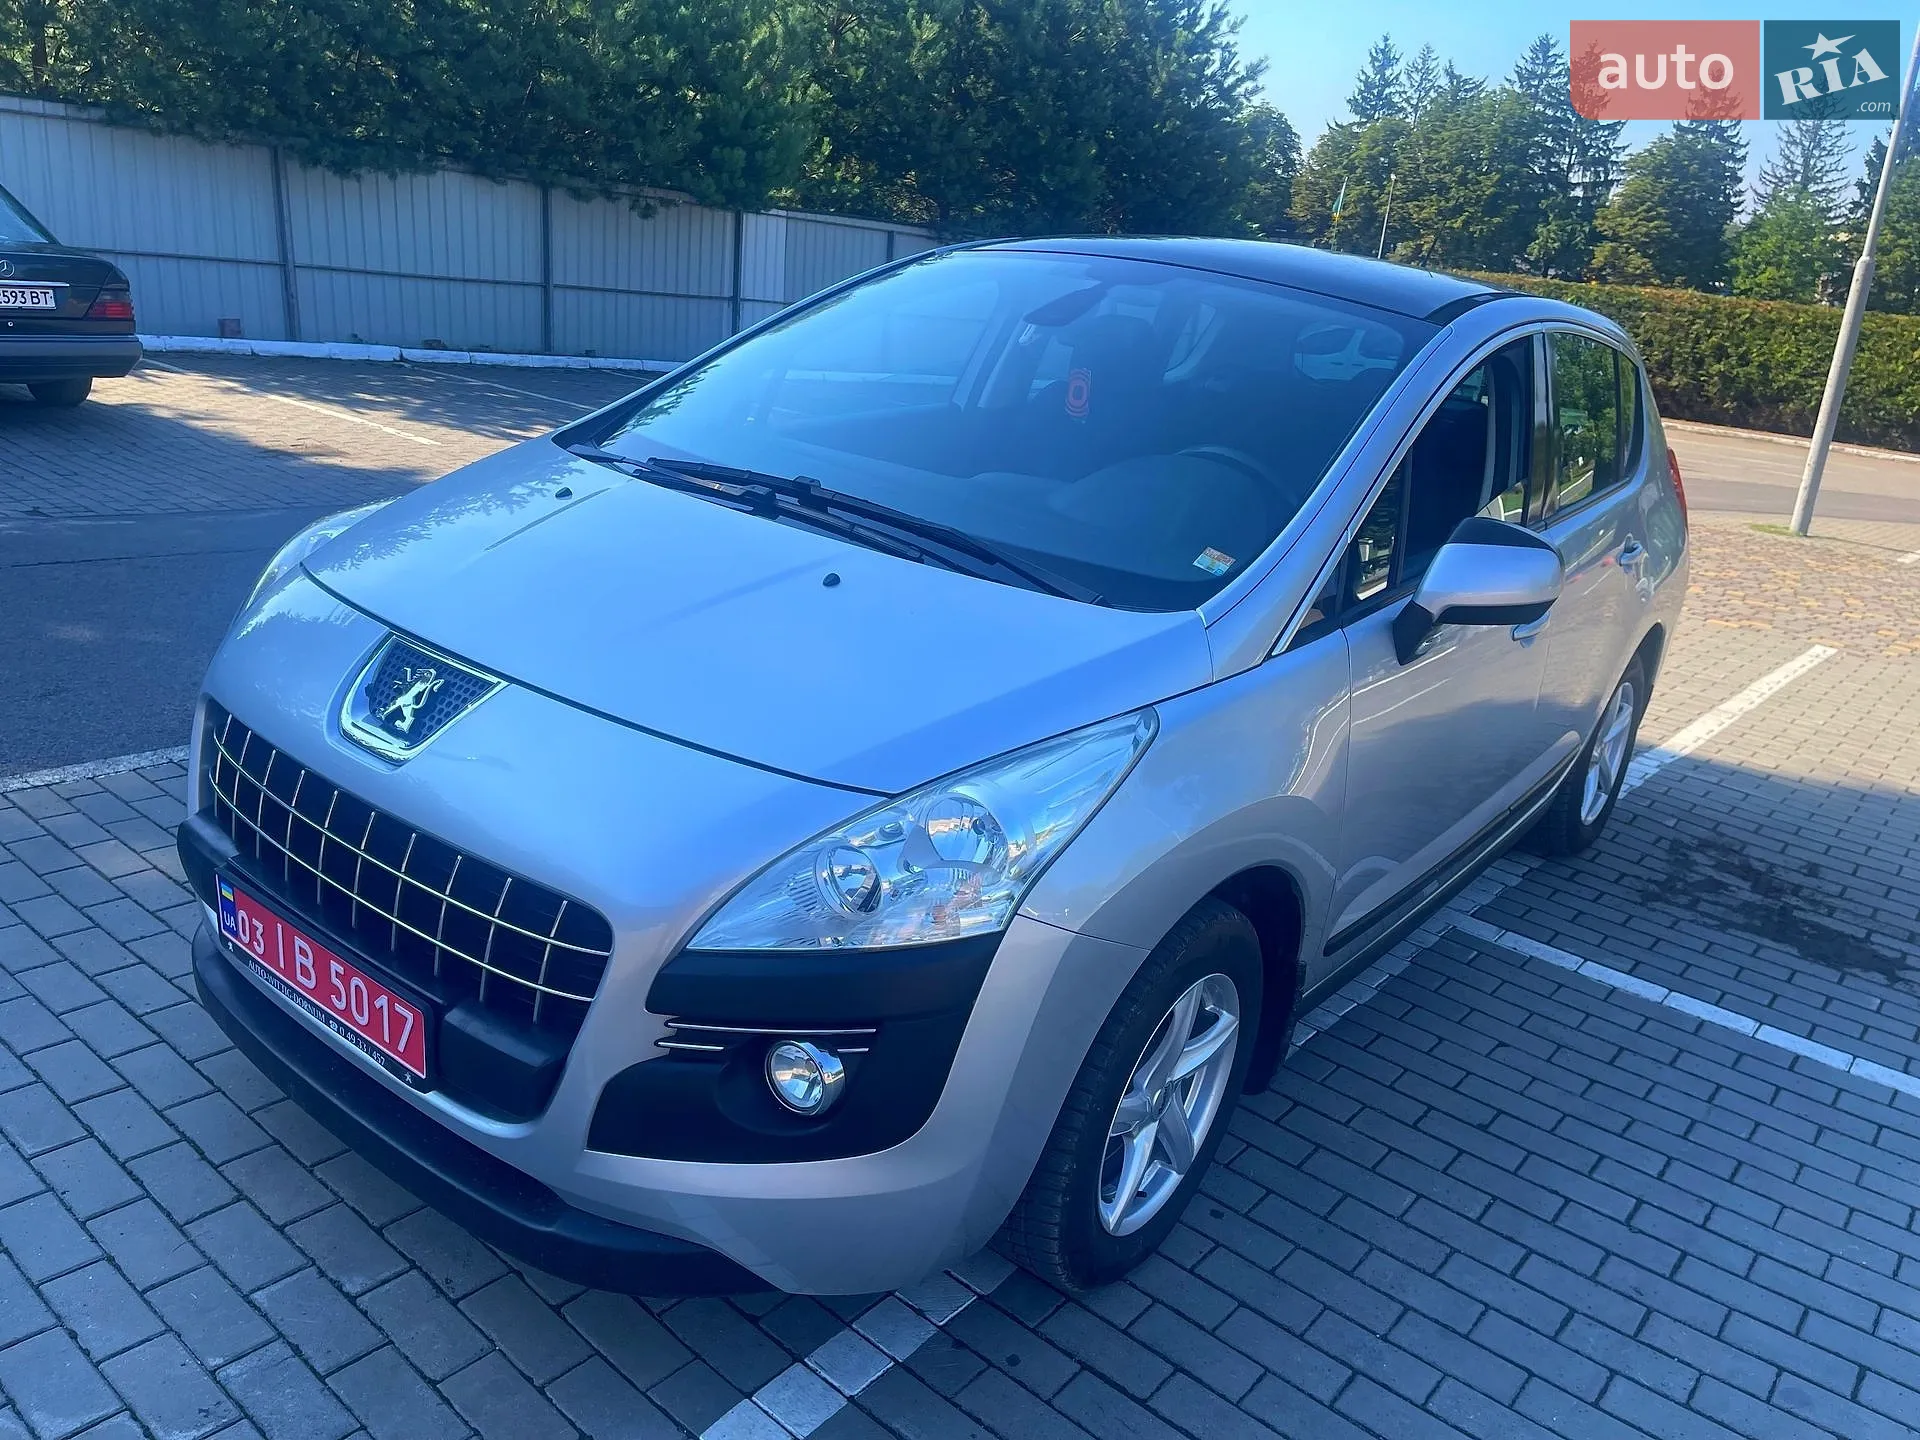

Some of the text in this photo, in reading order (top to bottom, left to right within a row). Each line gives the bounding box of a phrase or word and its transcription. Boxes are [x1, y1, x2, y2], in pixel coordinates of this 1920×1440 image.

[30, 290, 50, 305] BT
[223, 910, 237, 932] UA
[238, 909, 265, 955] 03
[330, 959, 414, 1054] 5017
